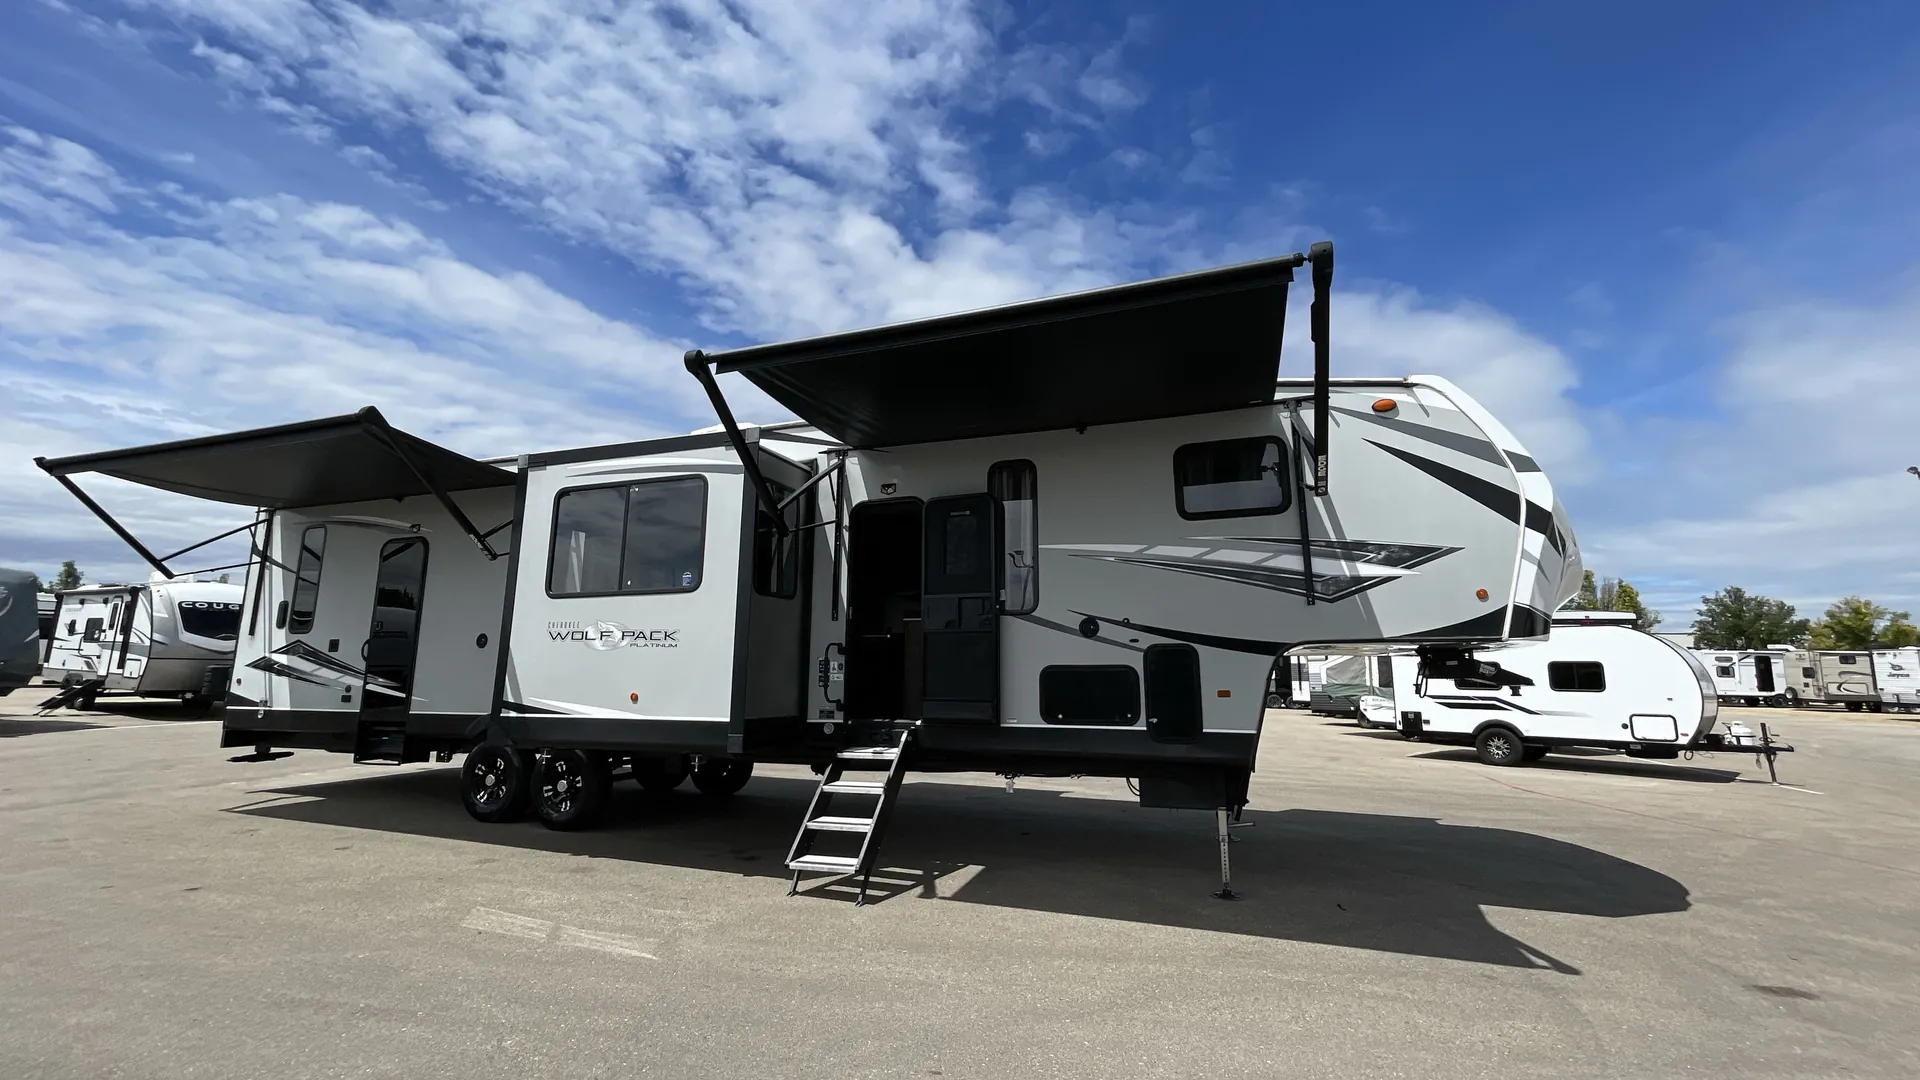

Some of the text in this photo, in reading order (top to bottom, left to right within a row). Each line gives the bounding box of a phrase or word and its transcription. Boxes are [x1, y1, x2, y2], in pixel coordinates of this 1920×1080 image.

[547, 621, 580, 629] CHEROKEE
[548, 630, 678, 641] WOLF PACK
